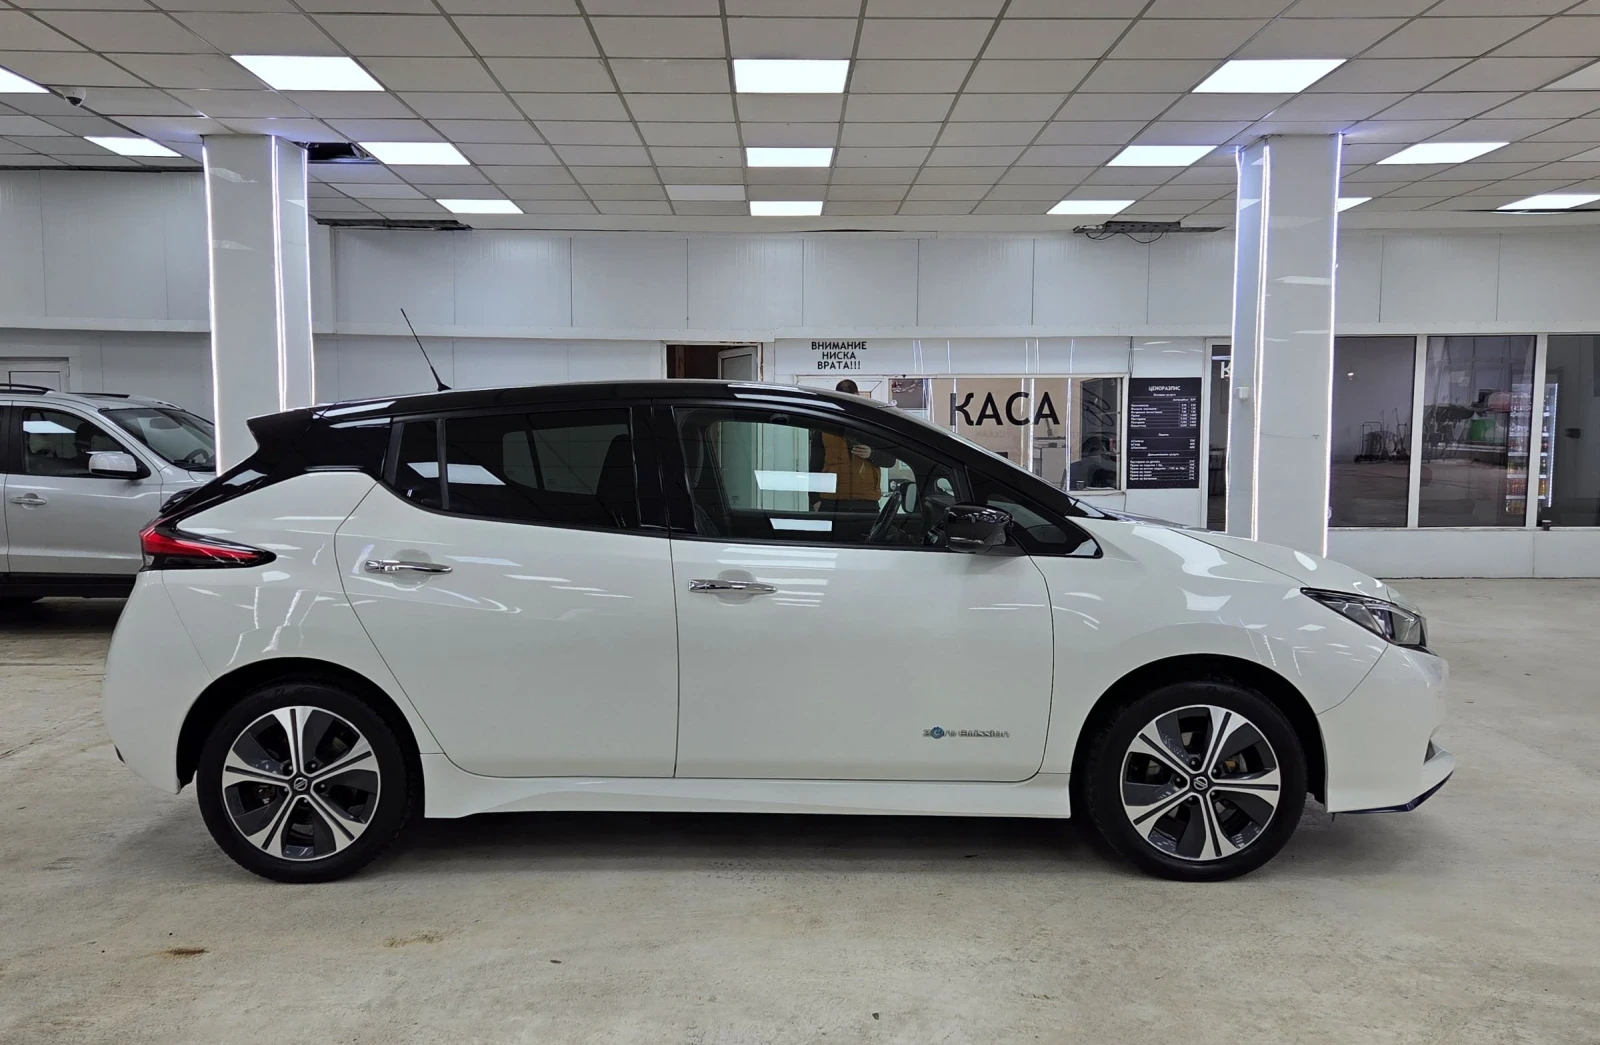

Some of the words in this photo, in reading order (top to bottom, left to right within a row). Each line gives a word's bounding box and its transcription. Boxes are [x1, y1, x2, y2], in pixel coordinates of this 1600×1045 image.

[811, 341, 867, 350] ВНИМАНИЕ
[822, 351, 856, 360] НИСКА
[817, 360, 861, 370] ВРАТА!!!
[950, 391, 1060, 427] КАСА
